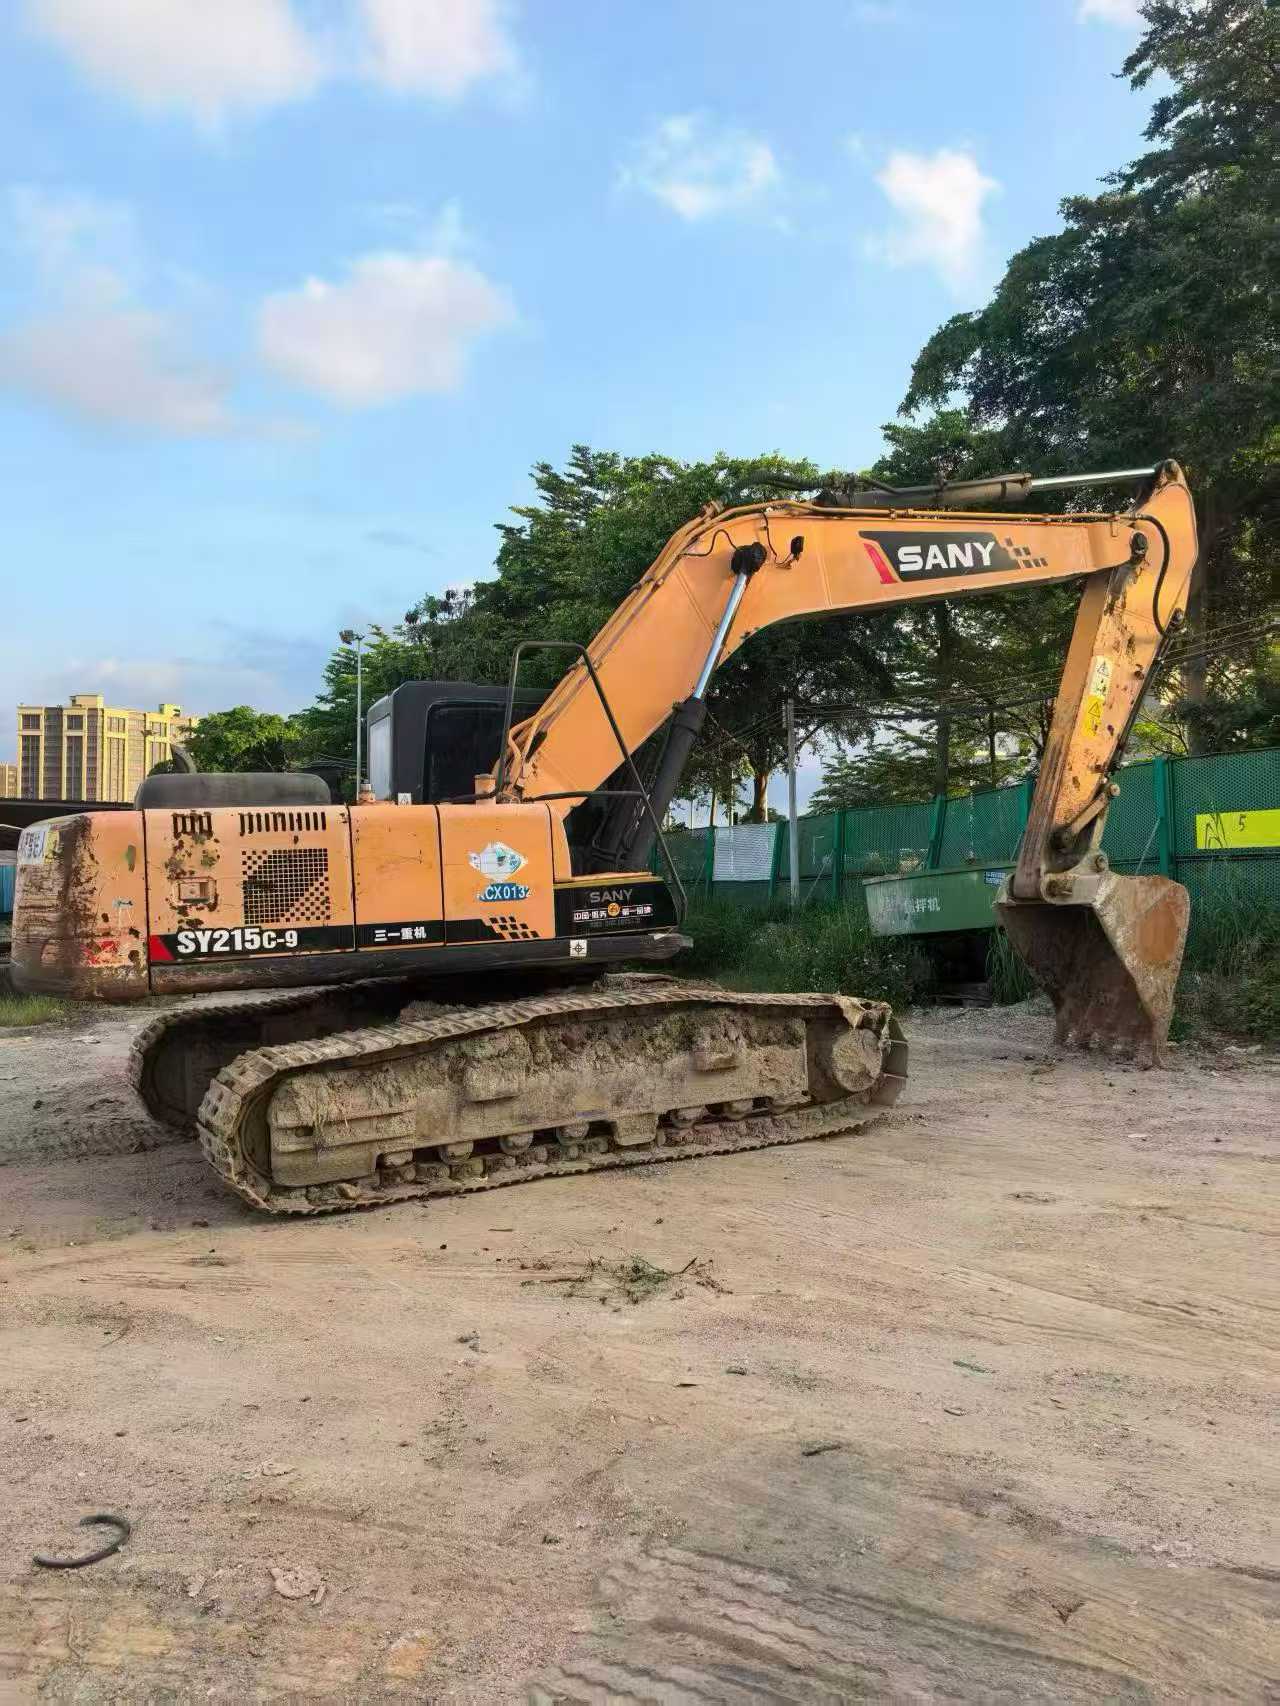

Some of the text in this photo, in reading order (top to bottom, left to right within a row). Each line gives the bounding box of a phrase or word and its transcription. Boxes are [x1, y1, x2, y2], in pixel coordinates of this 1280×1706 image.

[897, 541, 995, 572] SANY
[590, 889, 632, 903] SANY
[177, 927, 298, 953] SY215C-9
[374, 926, 427, 942] 三一重机
